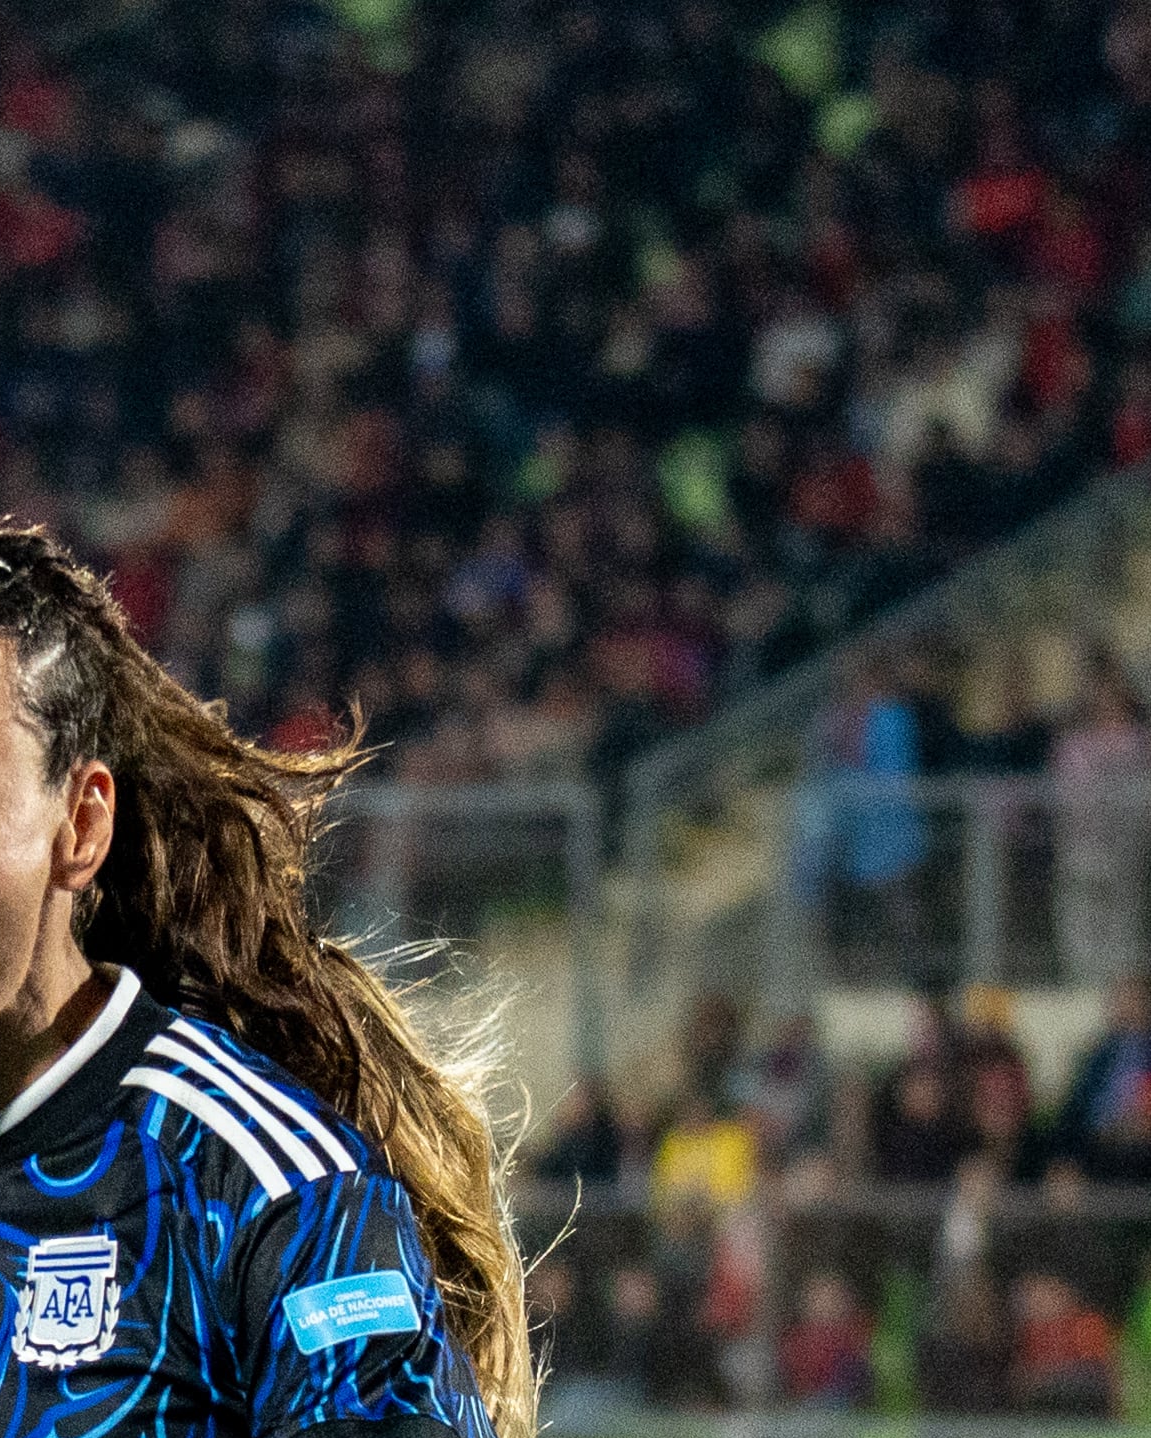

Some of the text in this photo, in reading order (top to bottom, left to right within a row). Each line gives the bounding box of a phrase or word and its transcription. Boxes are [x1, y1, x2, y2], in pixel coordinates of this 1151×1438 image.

[40, 1275, 94, 1328] AFA
[297, 1310, 328, 1329] LIGA
[328, 1303, 346, 1318] DE
[348, 1295, 406, 1313] NACIONES
